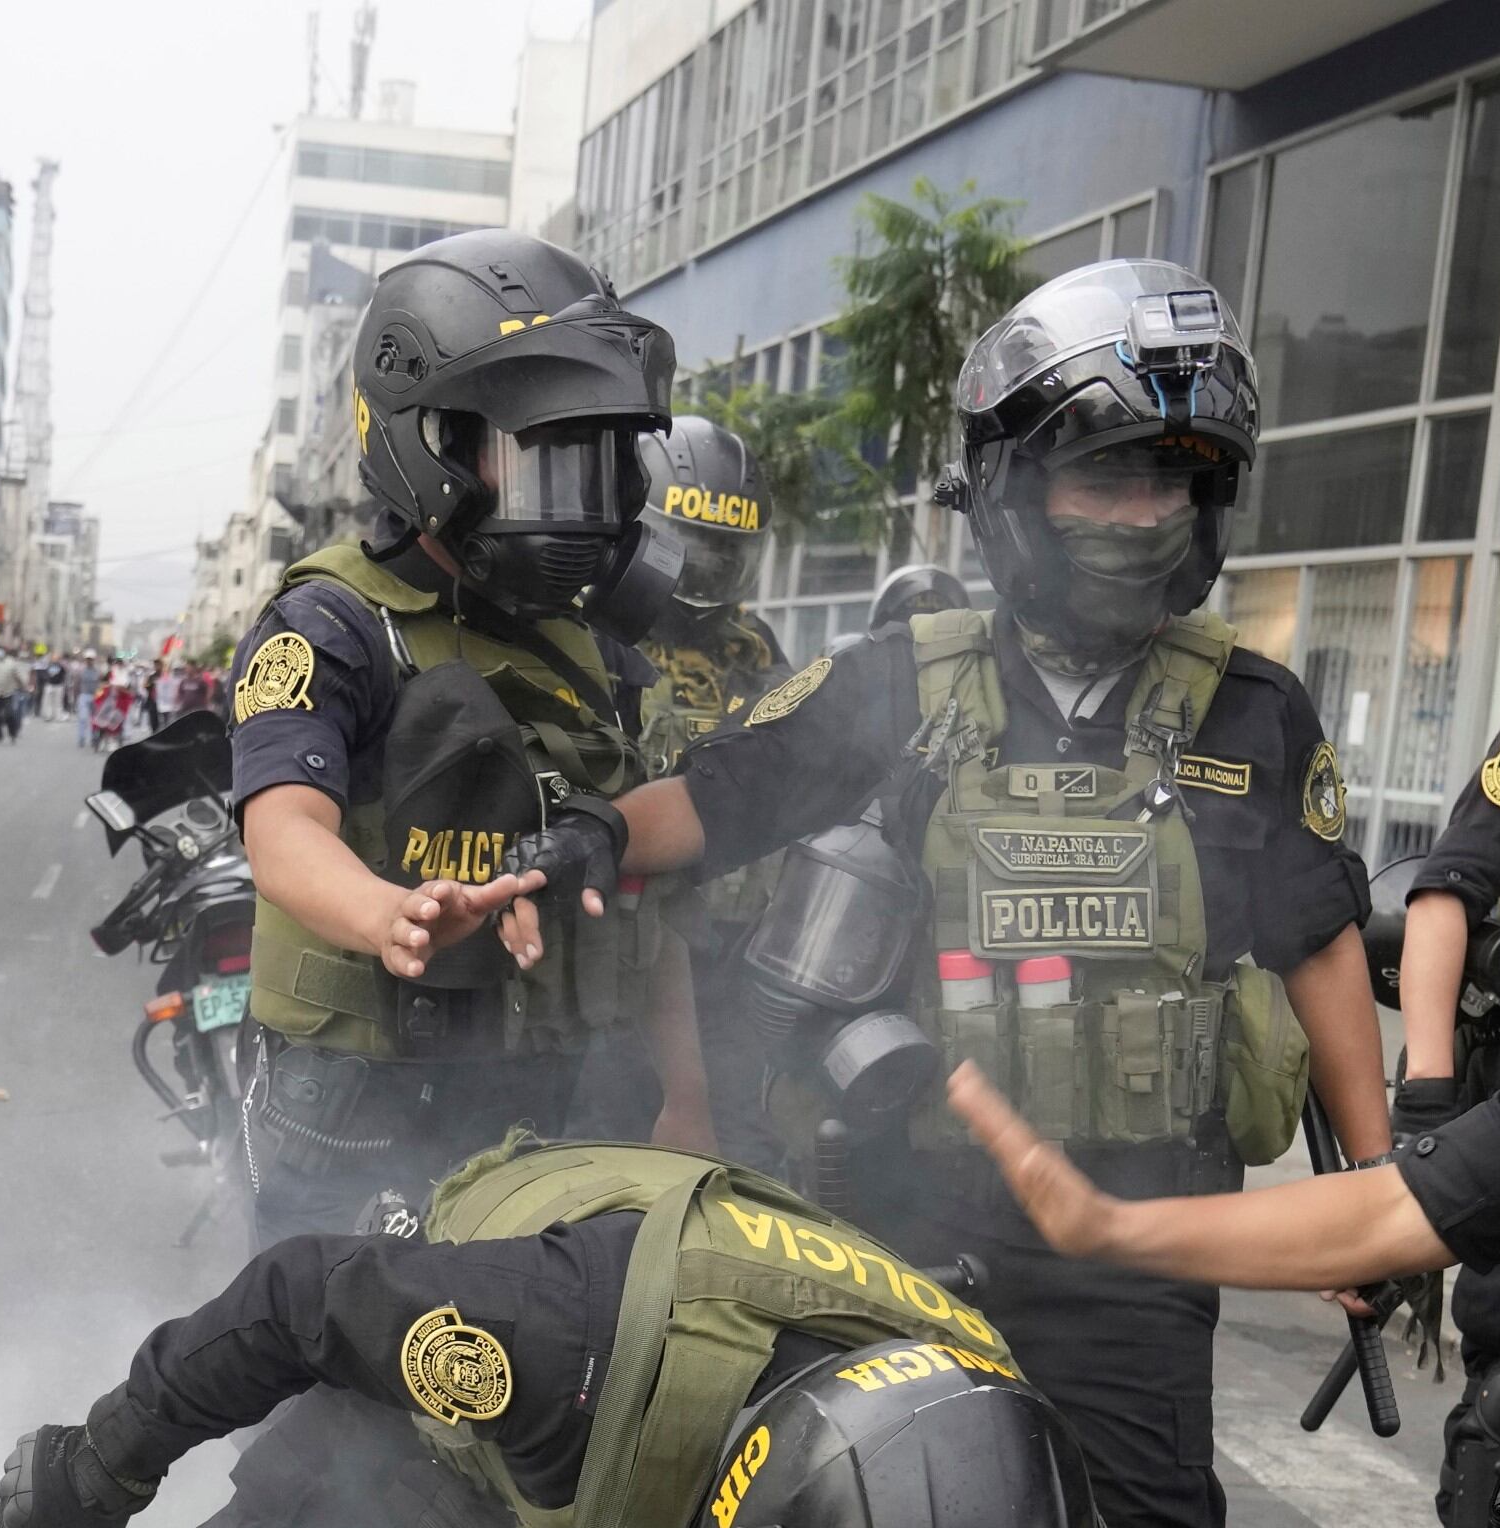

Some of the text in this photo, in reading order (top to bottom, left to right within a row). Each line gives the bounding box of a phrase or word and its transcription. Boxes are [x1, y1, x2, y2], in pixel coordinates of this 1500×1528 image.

[665, 486, 759, 530] POLICIA
[1071, 785, 1090, 794] POS
[1179, 761, 1244, 787] LICIA NACIONAL
[402, 826, 519, 883] POLICI
[1001, 836, 1127, 854] J. NAPANGA C.
[1011, 853, 1120, 866] SUBOFICIAL 3RA 2017
[991, 896, 1146, 940] POLICIA
[717, 1200, 996, 1346] POLICIA
[416, 1316, 447, 1342] REGION
[408, 1339, 422, 1391] POLICIAL
[423, 1332, 456, 1404] PUEBLO HECHO LEY
[472, 1337, 506, 1414] POLICIA NACIONAL
[835, 1343, 1018, 1392] POLICIA
